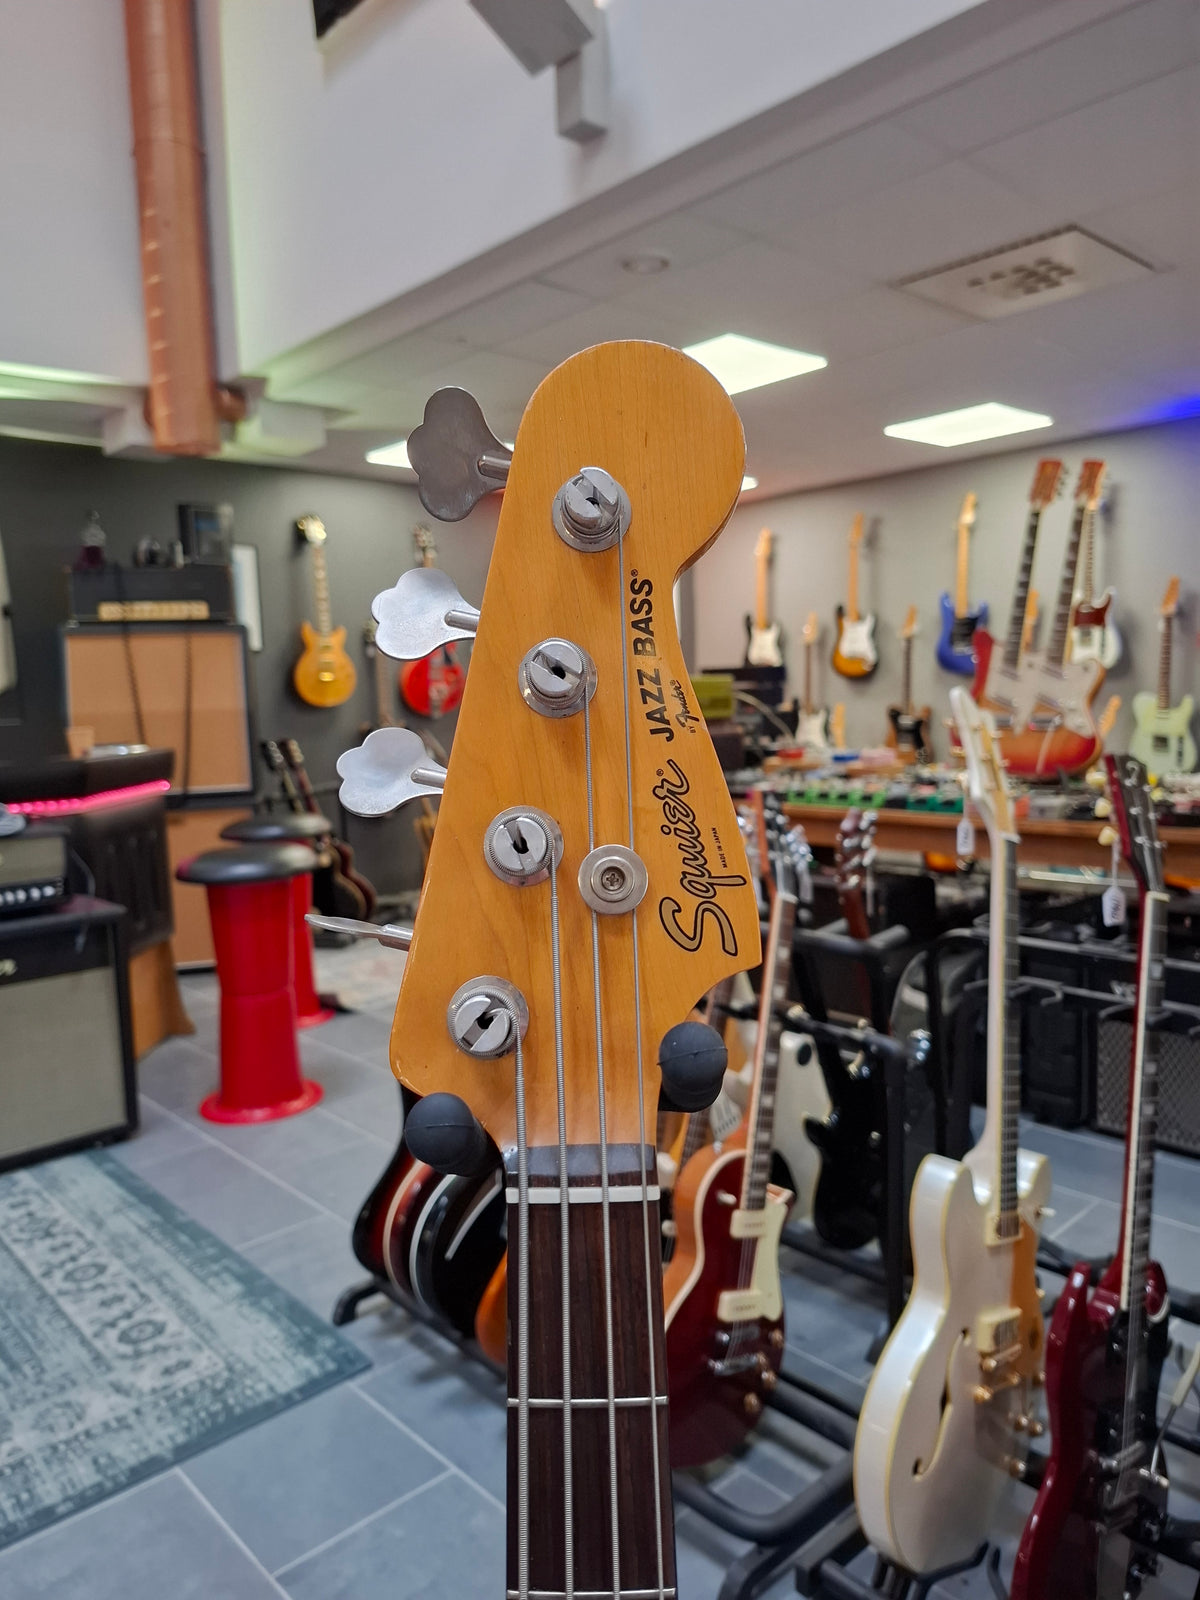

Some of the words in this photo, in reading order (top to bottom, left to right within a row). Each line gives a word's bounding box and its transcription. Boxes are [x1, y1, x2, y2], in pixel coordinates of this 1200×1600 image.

[629, 577, 657, 657] BASS
[636, 668, 675, 743] JAZZ
[670, 679, 700, 728] Fender
[652, 758, 747, 957] Squier
[711, 827, 721, 844] JAPAN
[716, 844, 723, 852] IN
[718, 853, 728, 869] MADE
